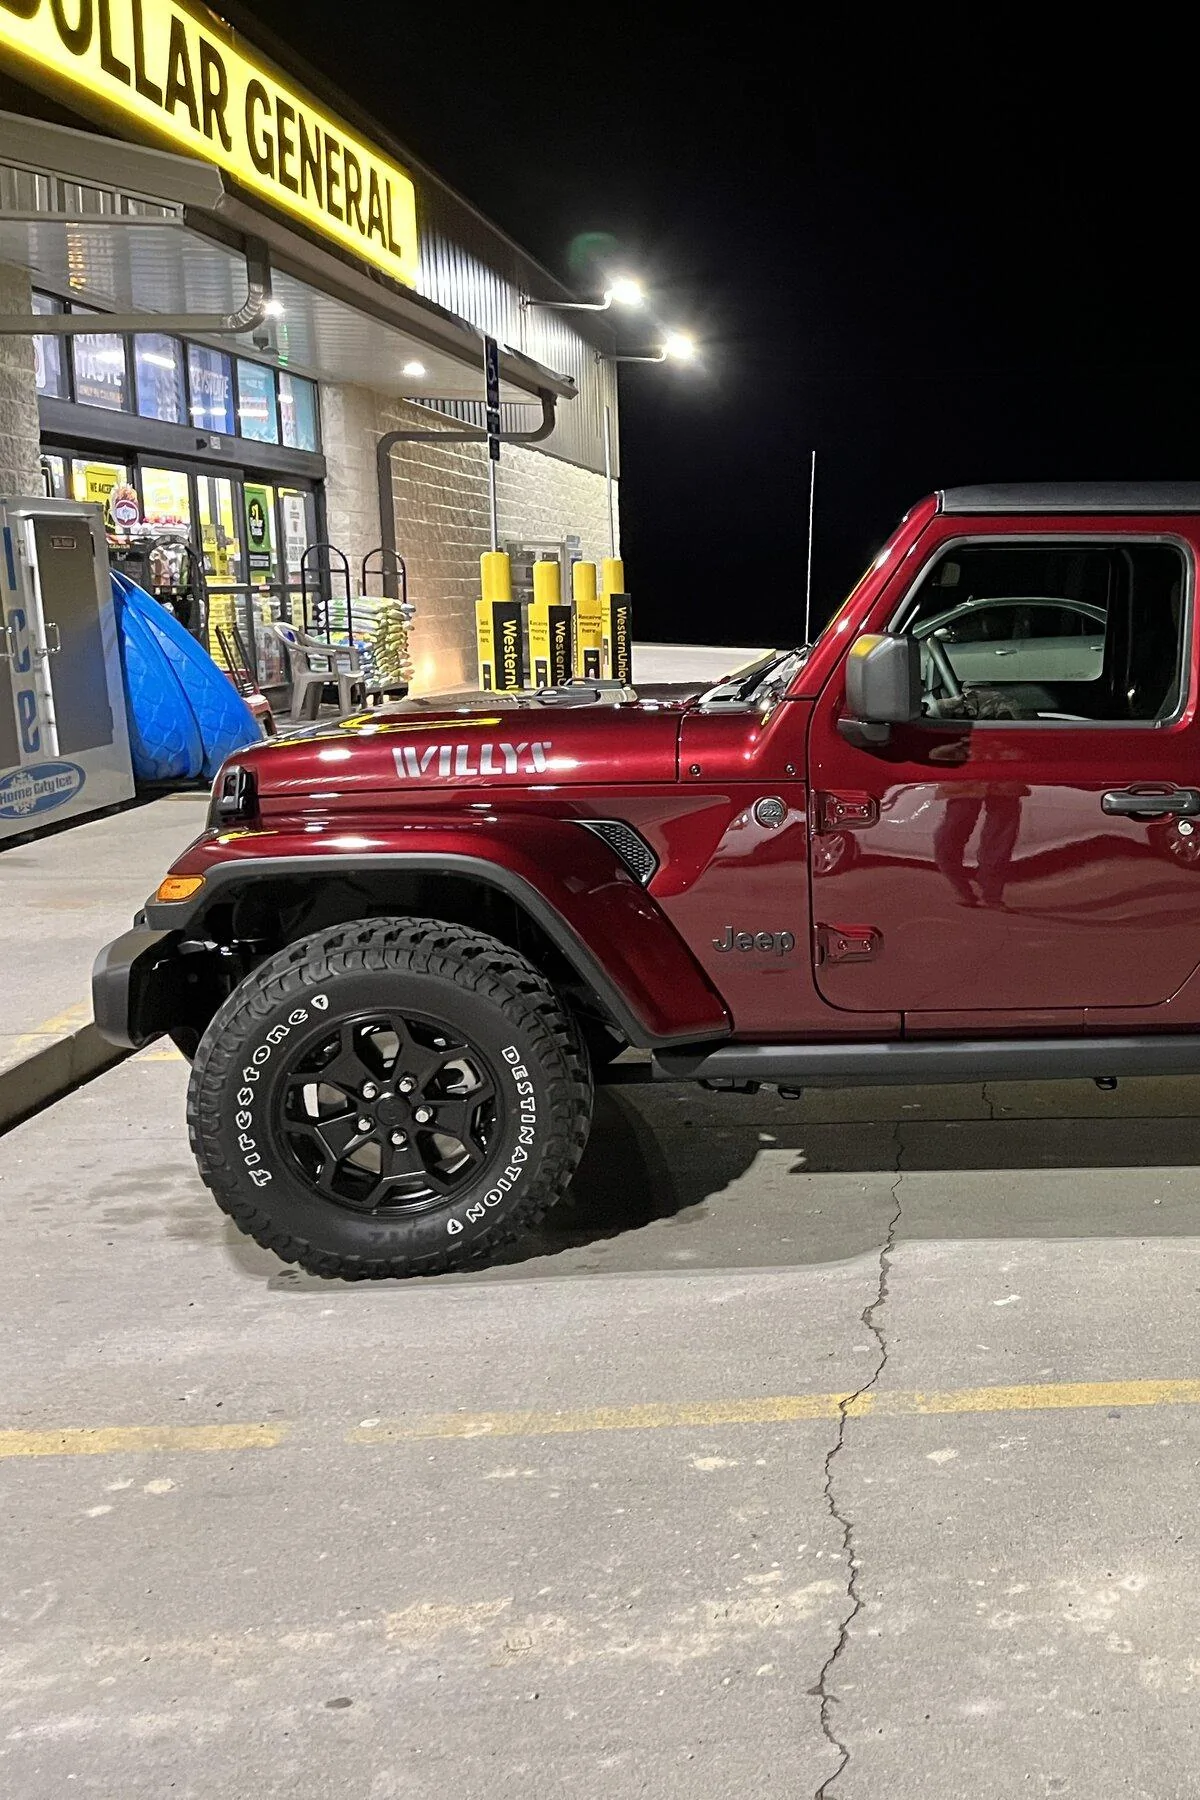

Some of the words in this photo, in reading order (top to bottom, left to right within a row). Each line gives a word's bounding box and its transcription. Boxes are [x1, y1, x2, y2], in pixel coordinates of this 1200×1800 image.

[0, 0, 232, 152] OLLAR
[245, 78, 402, 258] GENERAL
[0, 787, 32, 805] Home
[33, 780, 55, 796] City
[56, 775, 72, 789] Ice
[392, 742, 552, 778] WILLYS
[712, 925, 795, 957] Jeep
[236, 1007, 311, 1187] Firestone
[465, 1045, 537, 1224] DESTINATION
